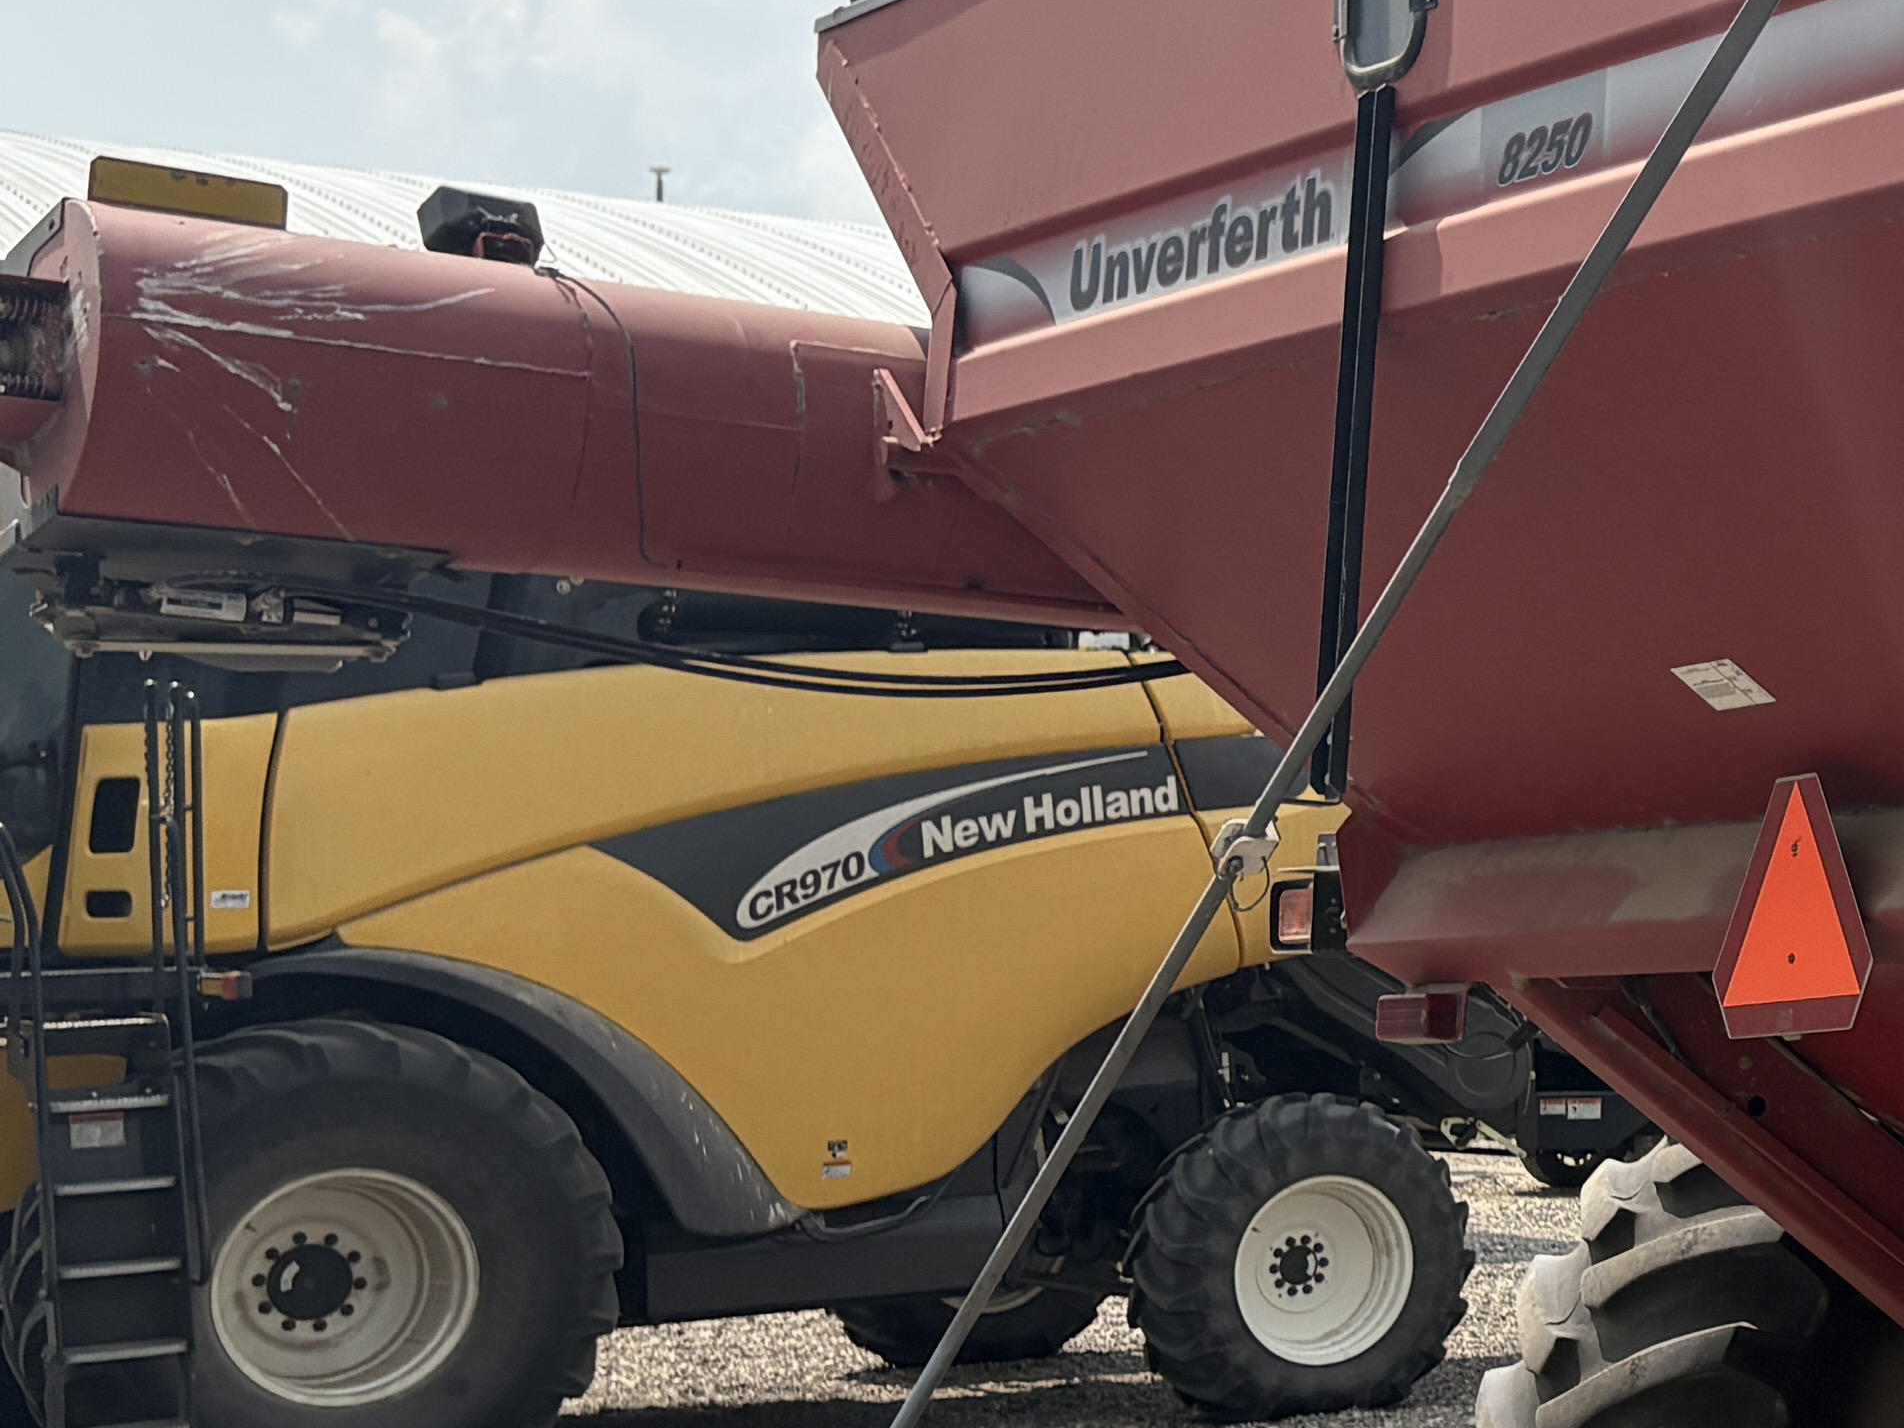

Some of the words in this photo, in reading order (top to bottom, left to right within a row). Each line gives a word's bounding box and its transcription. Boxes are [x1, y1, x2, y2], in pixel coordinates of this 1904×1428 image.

[1496, 111, 1594, 187] 8250
[1068, 176, 1333, 314] Unverferth
[920, 808, 1018, 859] New
[1023, 775, 1179, 833] Holland
[747, 849, 867, 923] CR970
